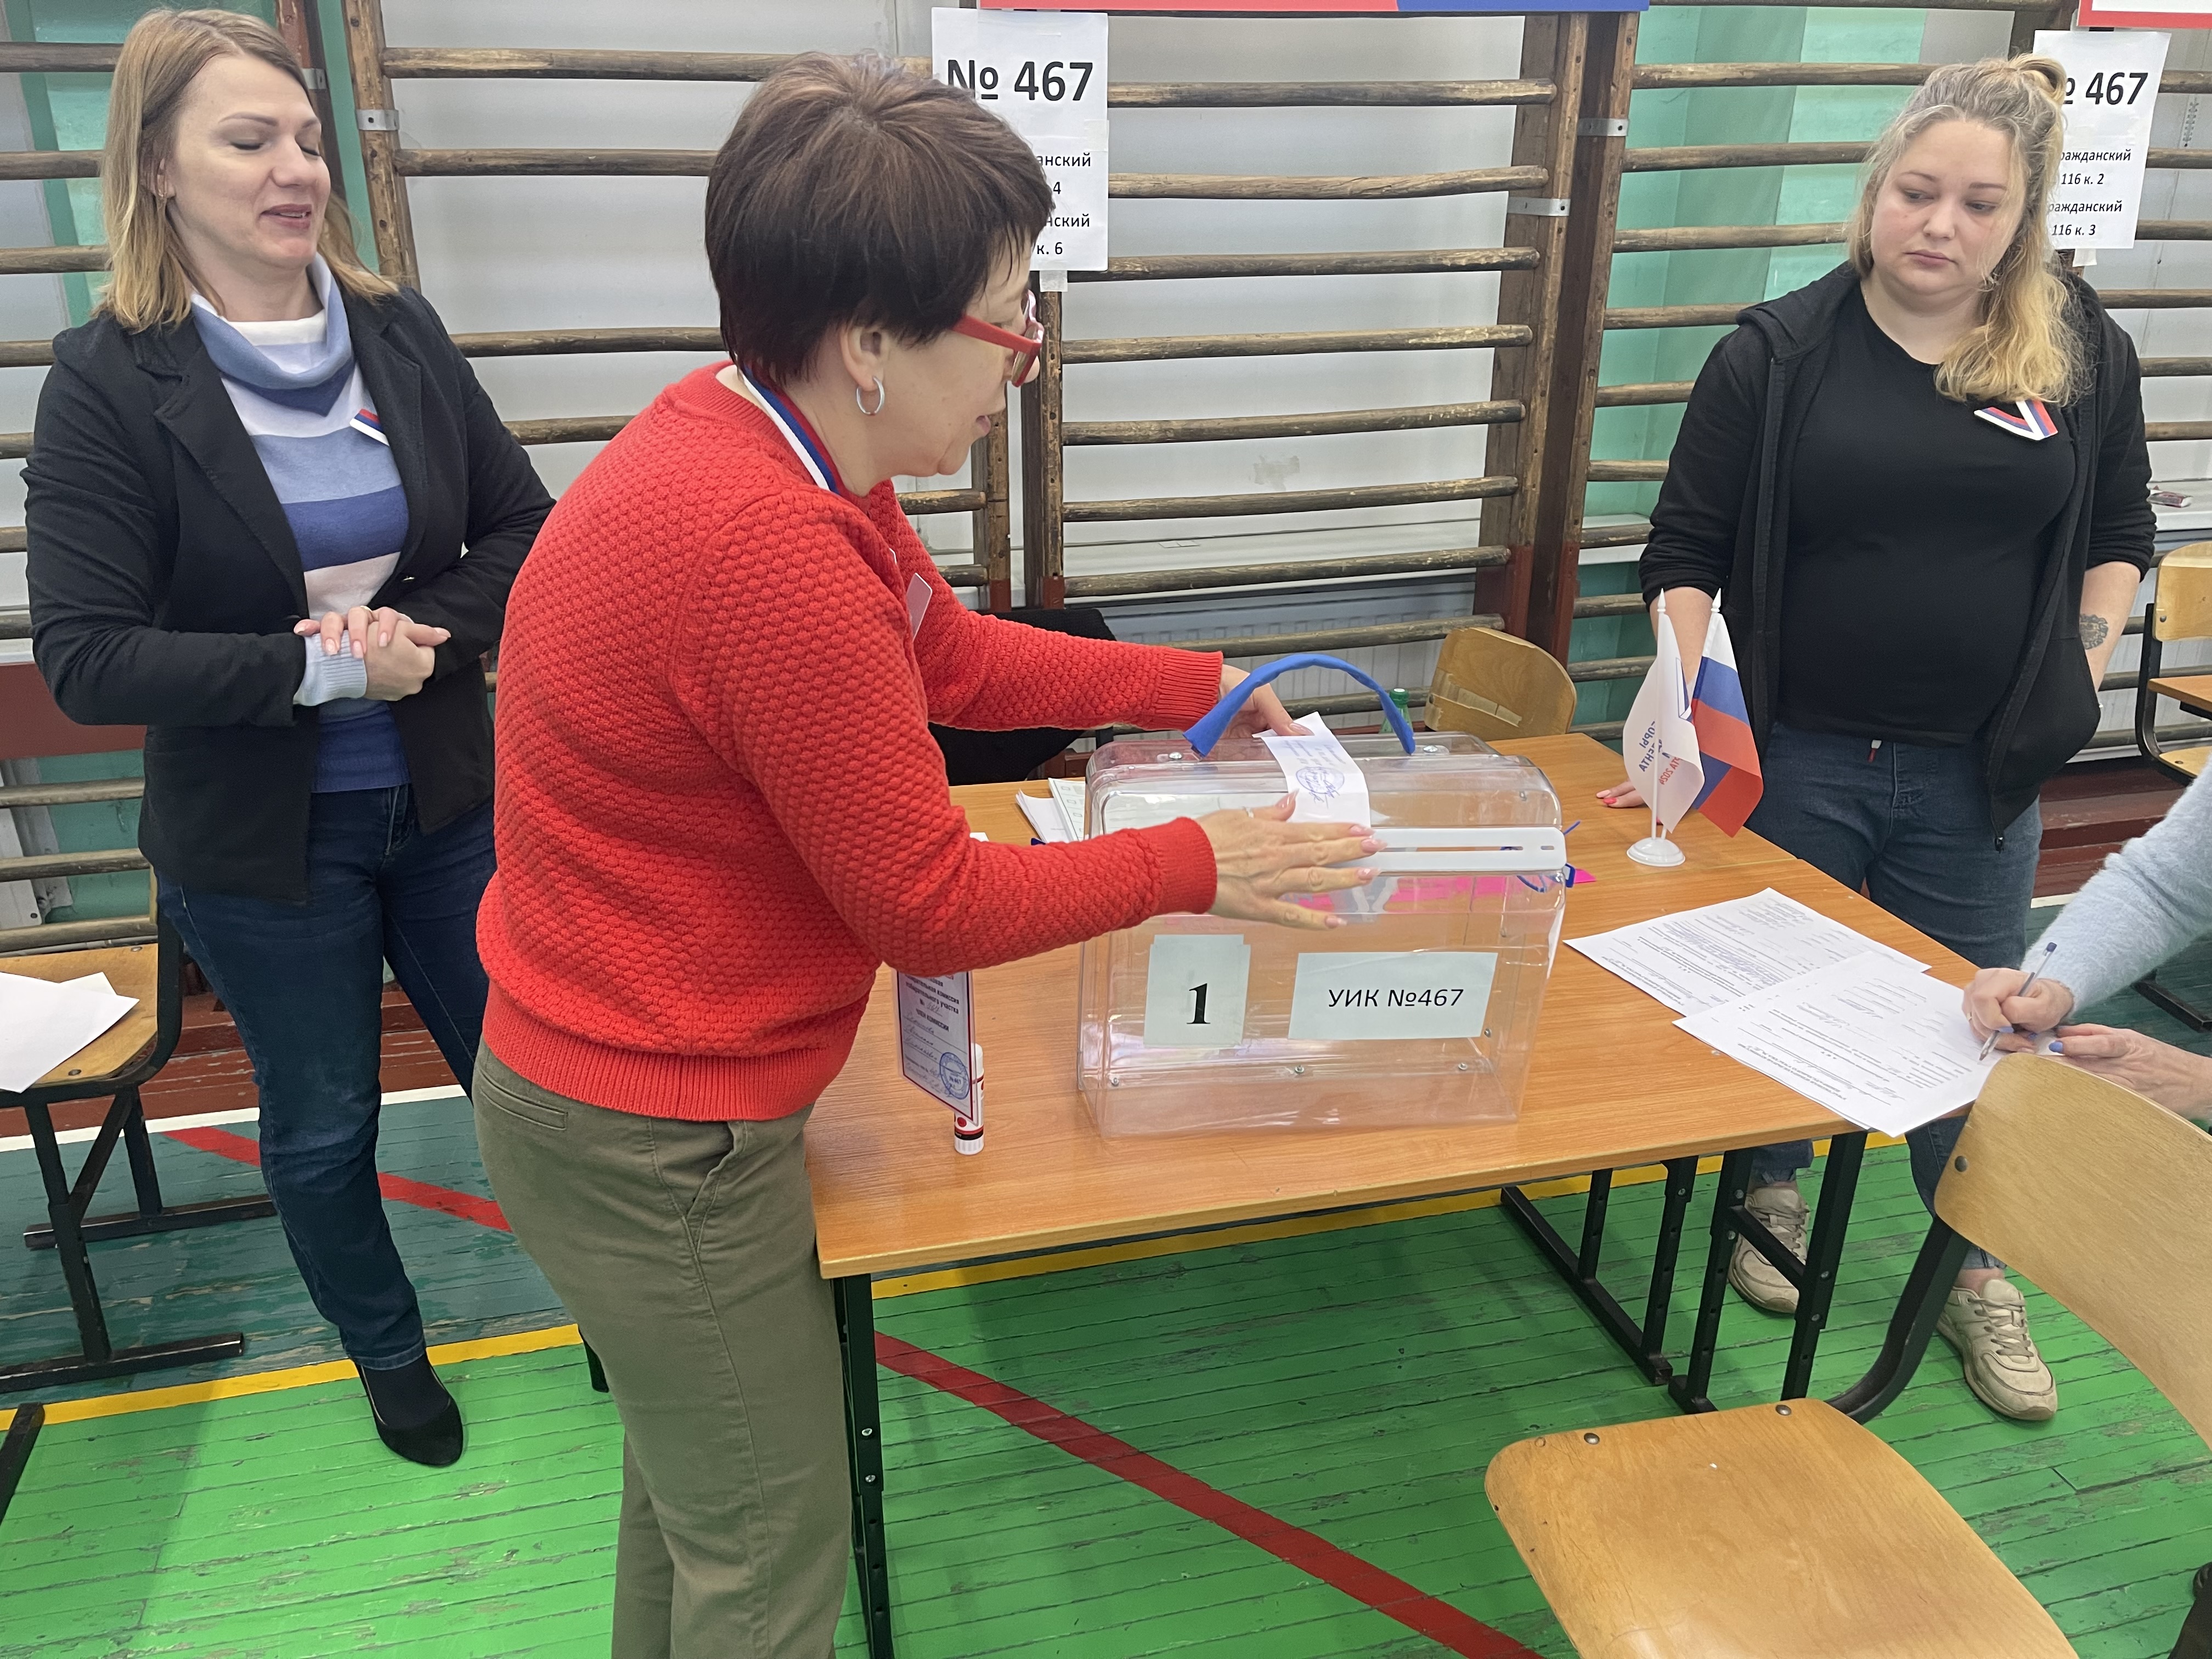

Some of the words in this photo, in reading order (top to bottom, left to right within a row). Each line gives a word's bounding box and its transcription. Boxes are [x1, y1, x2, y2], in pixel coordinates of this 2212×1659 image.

[1014, 61, 1093, 101] 467
[2085, 72, 2148, 105] 467
[2061, 173, 2081, 184] 116
[2084, 176, 2093, 184] к.
[2097, 173, 2104, 184] 2
[1053, 182, 1062, 195] 4
[2051, 224, 2072, 235] 116
[2075, 227, 2084, 235] к.
[2089, 224, 2096, 235] 3
[1037, 245, 1049, 255] к.
[1055, 242, 1063, 255] 6
[1186, 983, 1211, 1025] 1
[1328, 989, 1379, 1007] УИК
[1387, 988, 1464, 1008] №467
